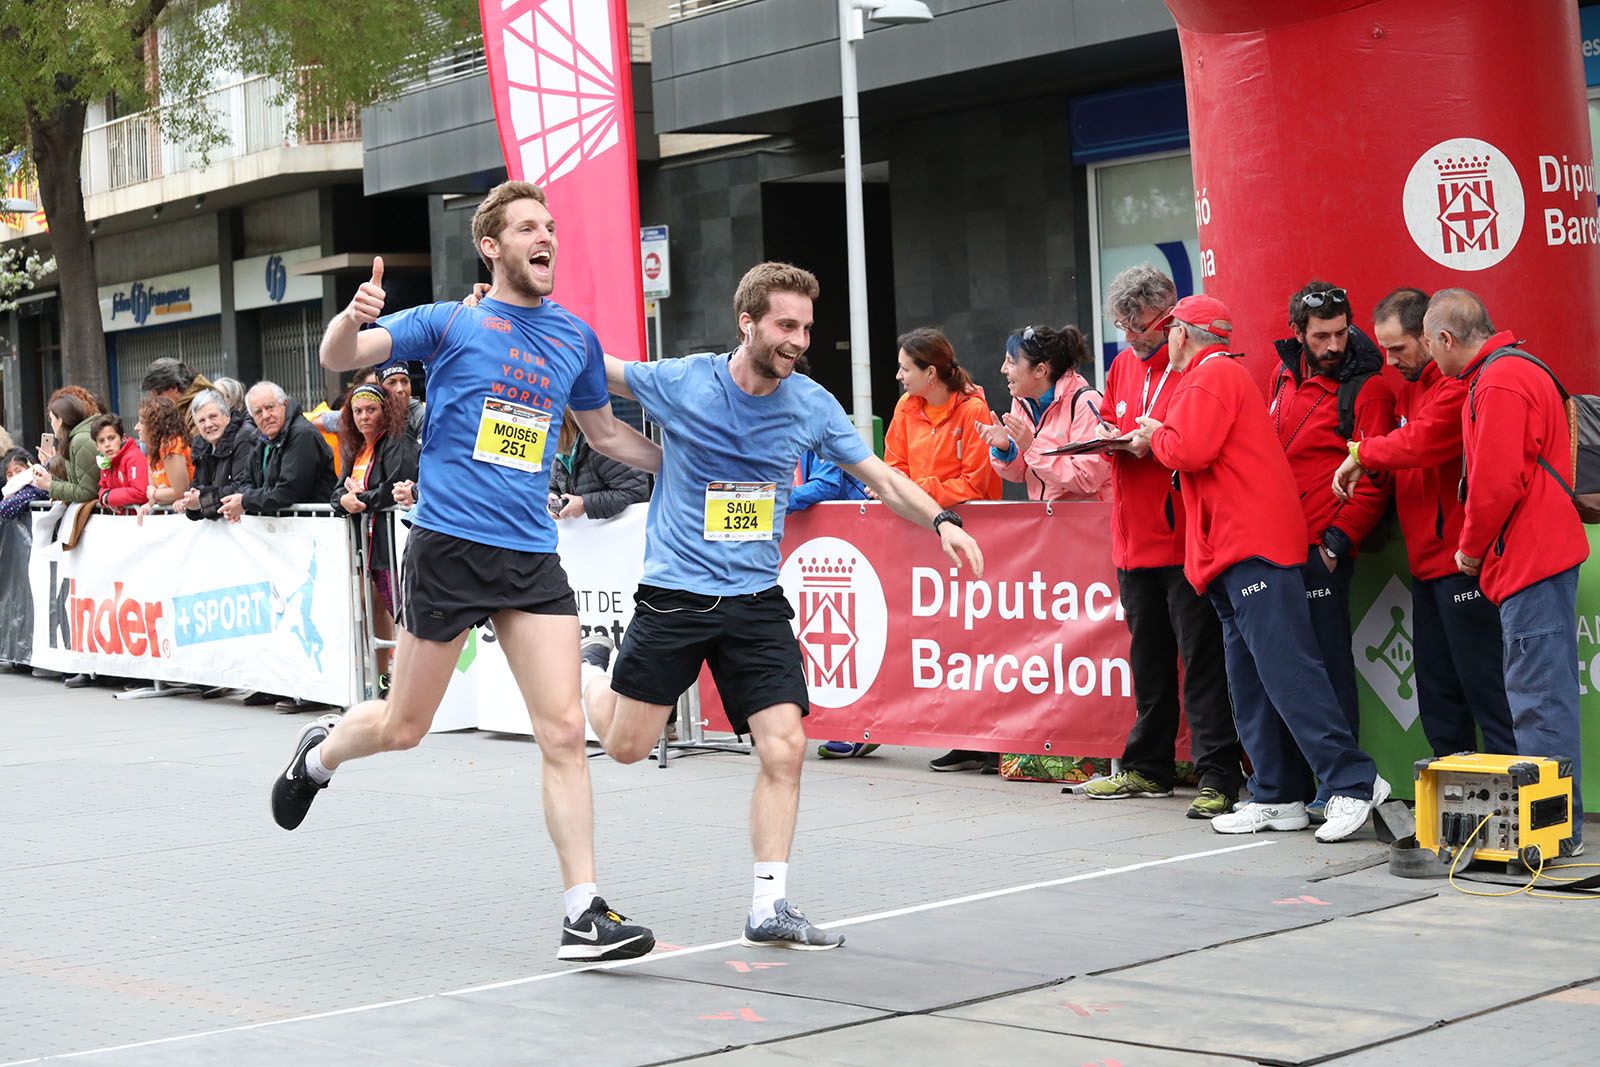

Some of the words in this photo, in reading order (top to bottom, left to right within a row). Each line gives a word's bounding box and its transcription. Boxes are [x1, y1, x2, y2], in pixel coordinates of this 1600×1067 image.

[509, 347, 546, 368] RUN
[502, 363, 551, 389] YOUR
[491, 381, 553, 410] WORLD
[499, 439, 526, 458] 251
[727, 500, 757, 514] SAÜL
[723, 515, 759, 530] 1324
[1241, 580, 1268, 597] RFEA
[1305, 588, 1331, 599] RFEA
[1453, 589, 1481, 603] RFEA
[598, 591, 624, 613] DE
